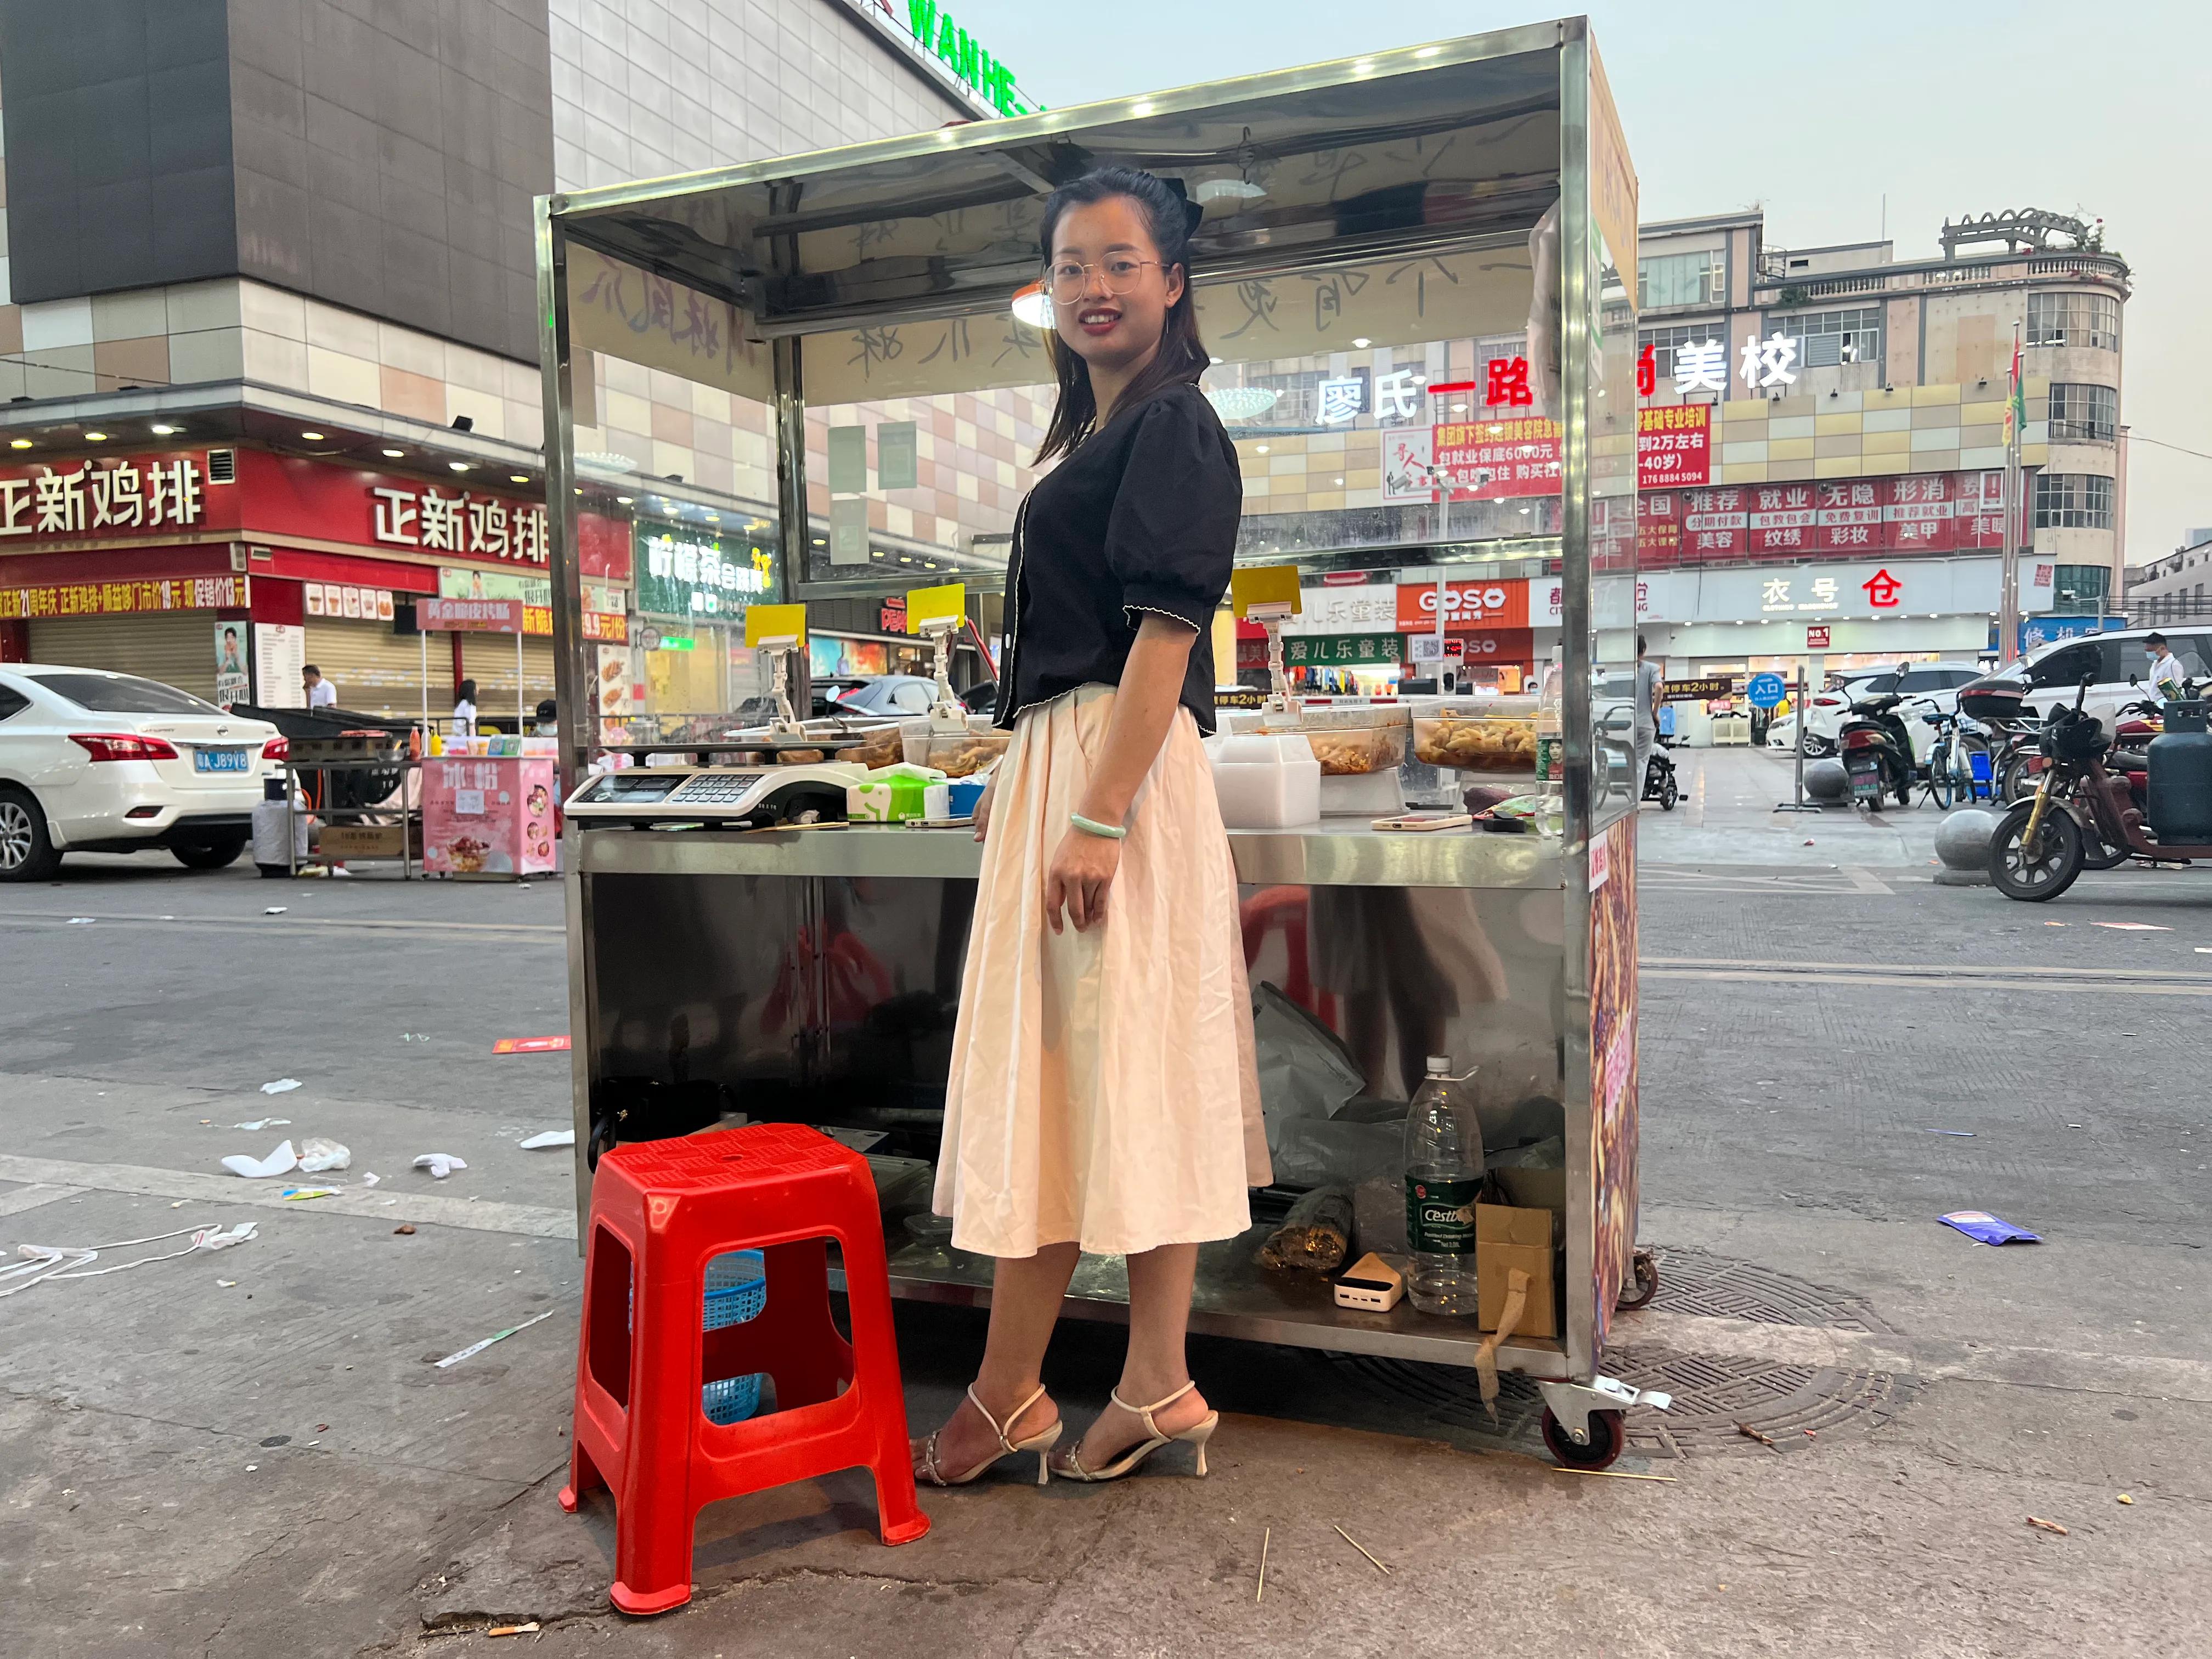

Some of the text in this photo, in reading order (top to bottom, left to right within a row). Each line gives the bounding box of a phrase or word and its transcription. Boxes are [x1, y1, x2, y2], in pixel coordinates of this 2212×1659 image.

[1681, 471, 1702, 482] 5094
[0, 459, 201, 536] 正新鸡排
[1691, 488, 1739, 512] 推荐
[1758, 487, 1808, 510] 就业
[1824, 483, 1875, 507] 无隐
[374, 486, 550, 563] 正新鸡排
[1691, 516, 1742, 529] 分期付款
[1697, 531, 1733, 550] 美容
[582, 613, 625, 639] 9.9元/份
[1290, 637, 1398, 660] 爱儿乐童装
